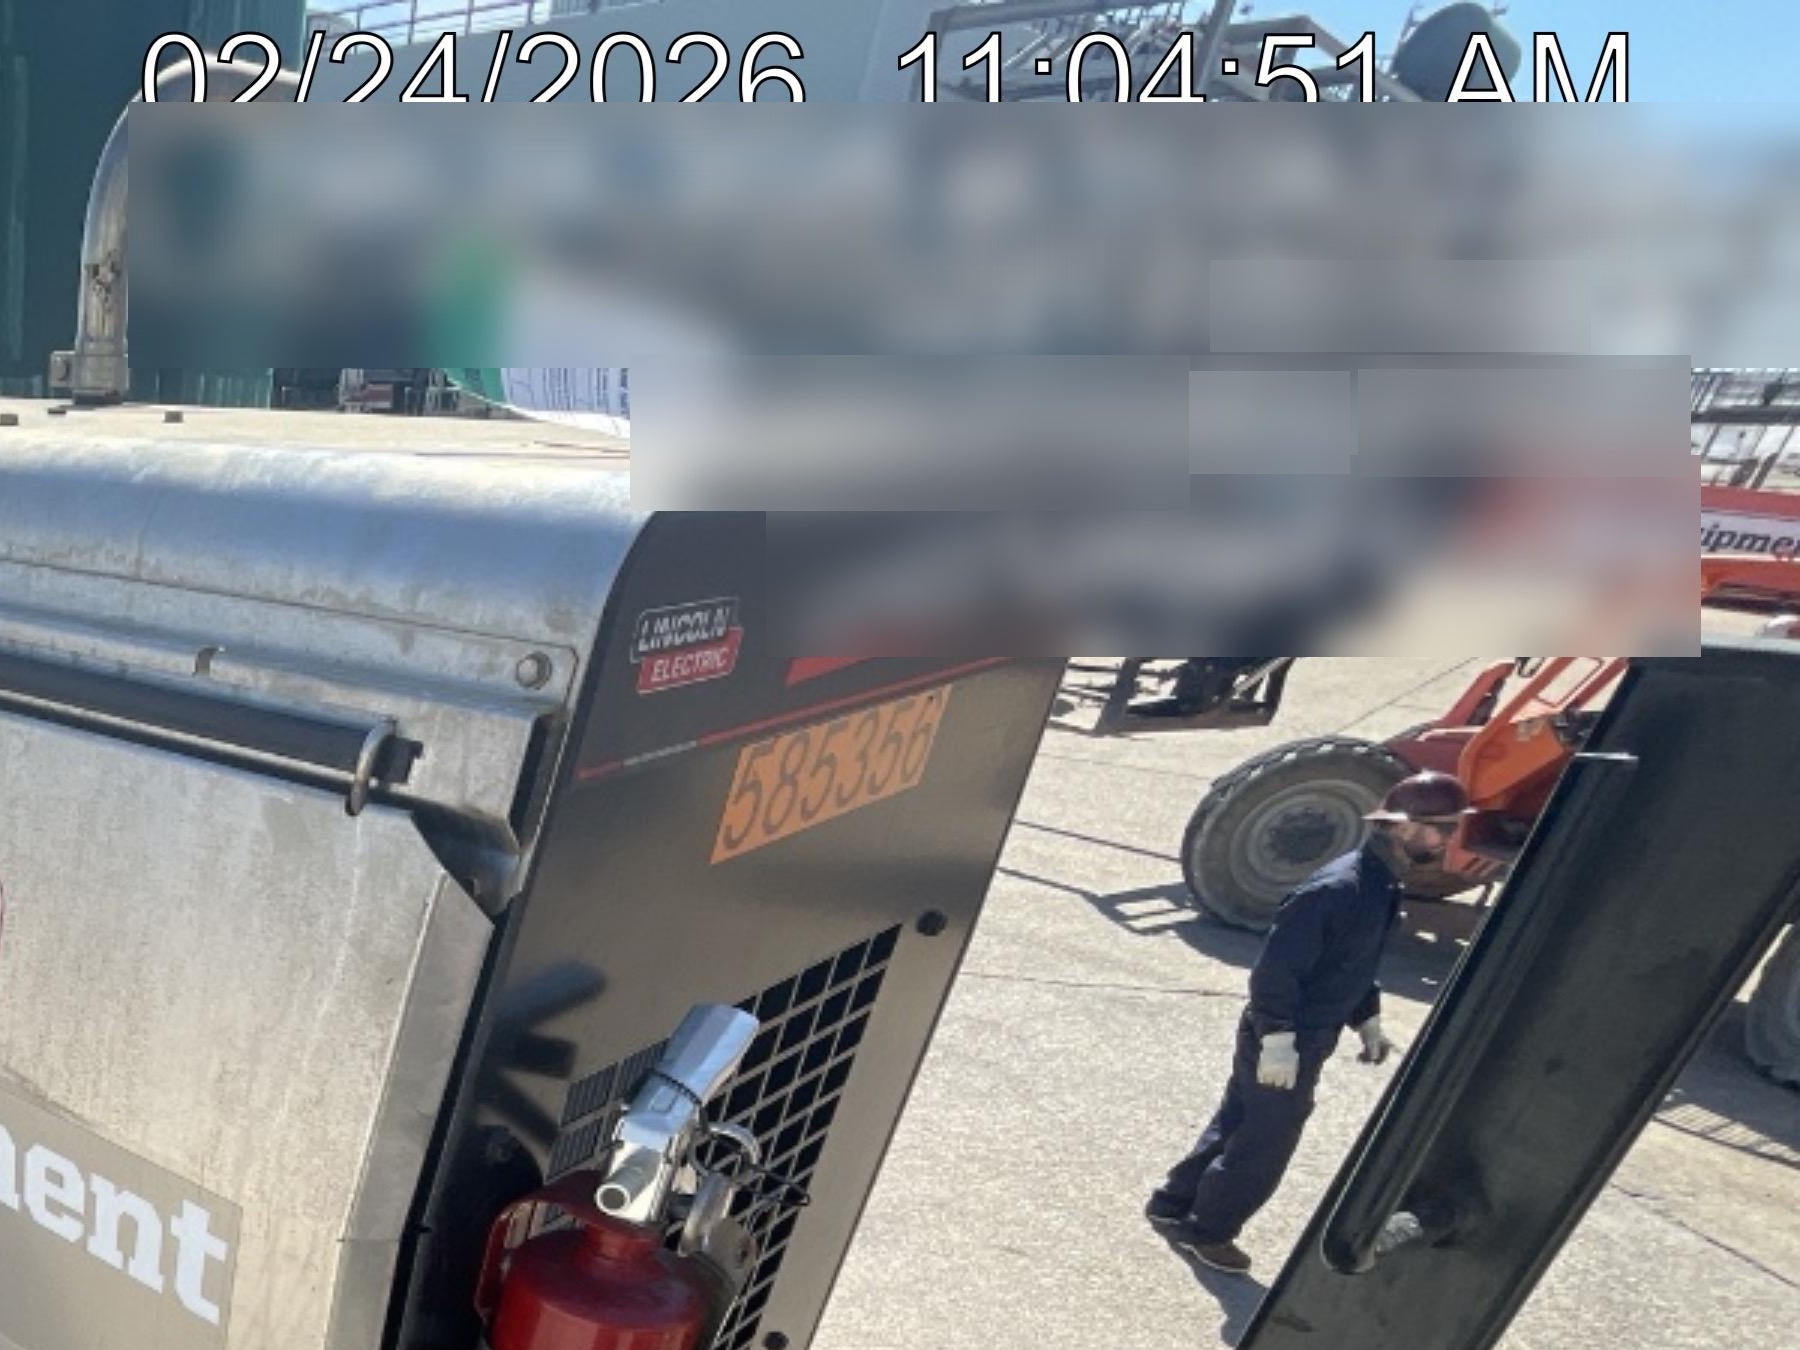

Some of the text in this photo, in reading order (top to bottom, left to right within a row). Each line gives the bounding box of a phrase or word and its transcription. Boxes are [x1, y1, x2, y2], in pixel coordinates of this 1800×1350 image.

[1701, 524, 1800, 557] ipme
[651, 647, 729, 682] ELECTRIC
[725, 697, 937, 850] 585356
